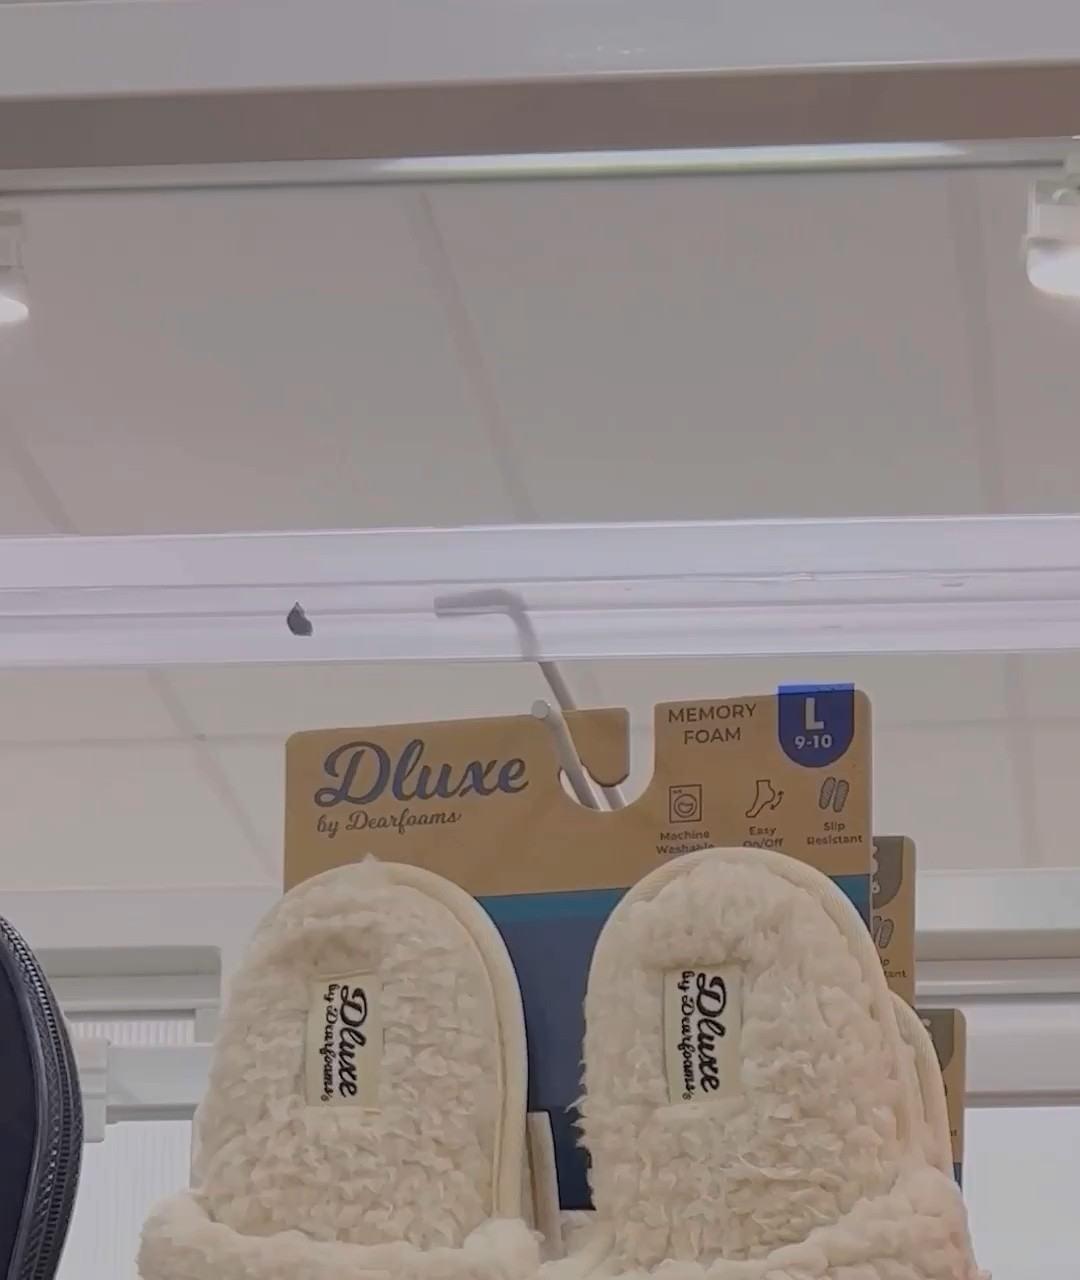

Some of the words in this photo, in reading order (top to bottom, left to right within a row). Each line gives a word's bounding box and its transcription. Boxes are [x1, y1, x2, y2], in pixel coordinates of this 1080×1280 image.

[668, 703, 757, 723] MEMORY
[804, 697, 824, 730] L
[684, 727, 741, 745] FOAM
[794, 735, 832, 749] 9-10
[314, 739, 529, 808] Dluxe
[317, 812, 339, 837] by
[346, 809, 461, 835] Dearfoams
[749, 826, 776, 837] Easy
[823, 822, 845, 832] Slip
[660, 830, 710, 841] Machine
[807, 835, 863, 846] Resistant
[677, 970, 694, 993] by
[327, 984, 340, 1004] by
[338, 985, 368, 1098] Dluxe
[696, 972, 726, 1093] Dluxe
